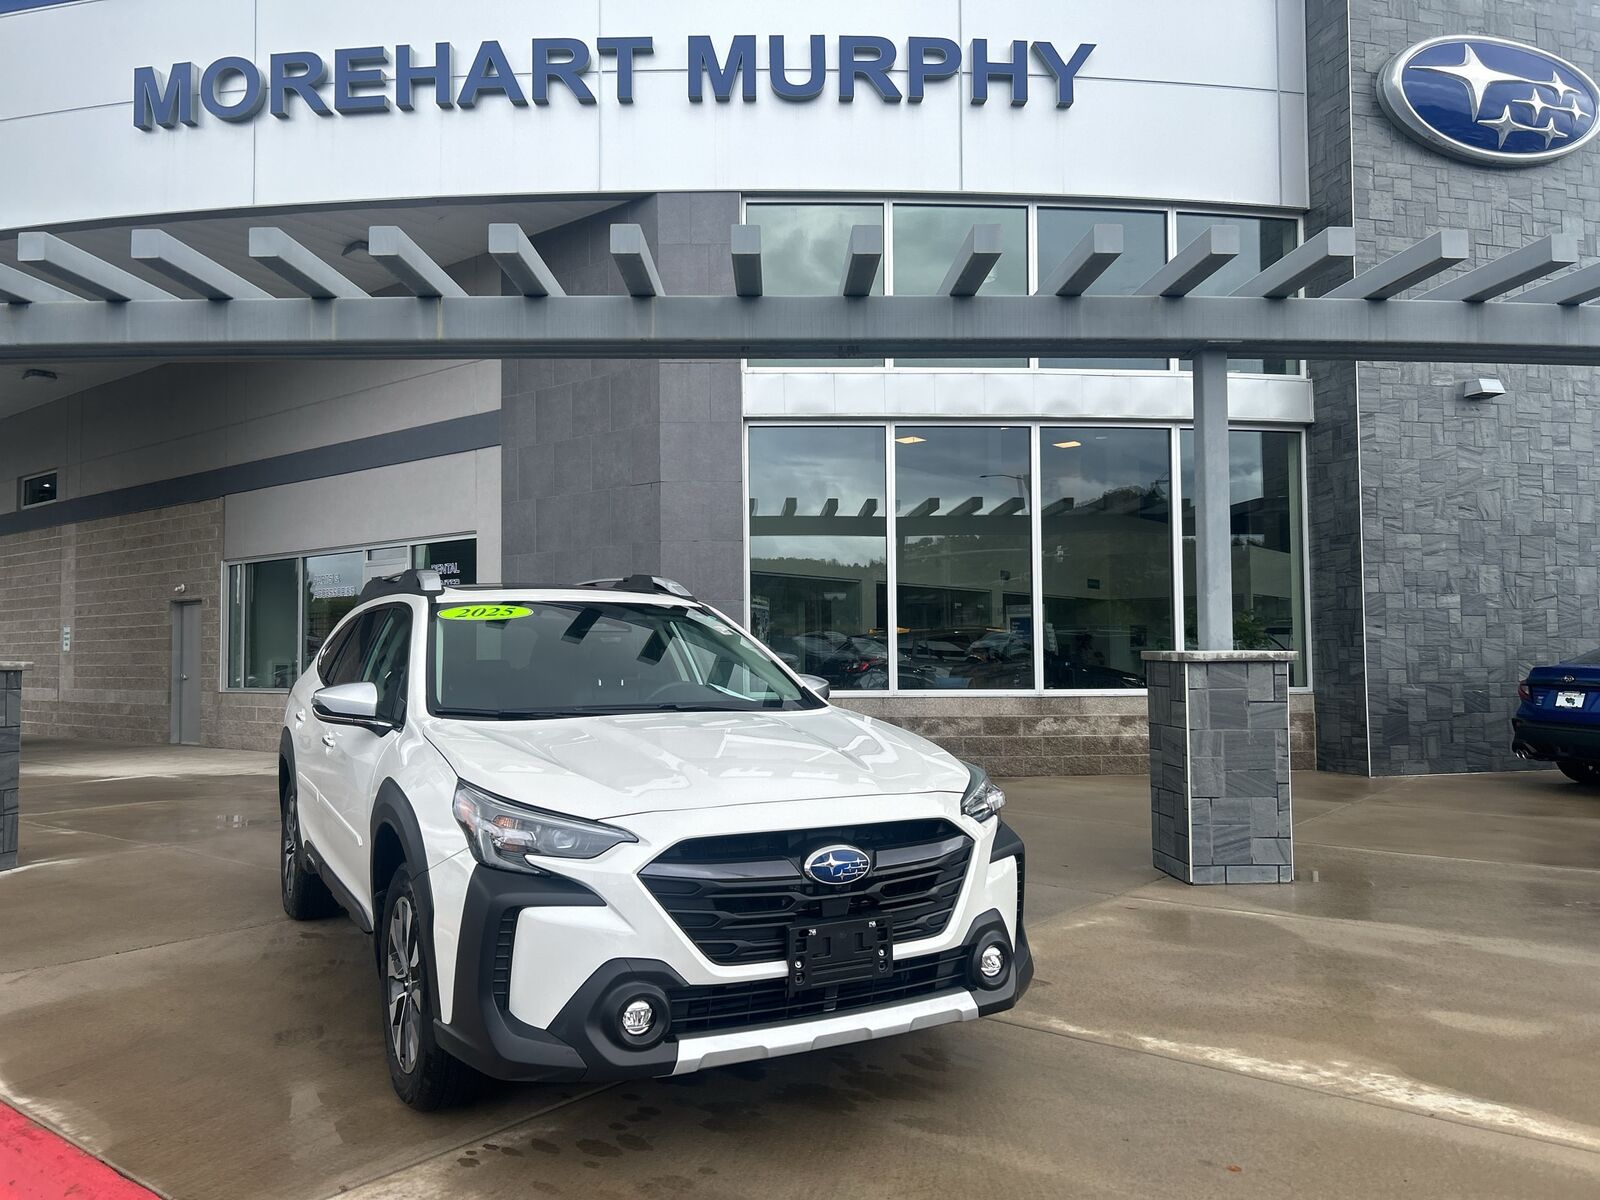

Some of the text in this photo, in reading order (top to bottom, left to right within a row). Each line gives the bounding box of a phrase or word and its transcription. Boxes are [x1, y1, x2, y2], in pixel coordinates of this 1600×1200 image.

[133, 34, 1097, 131] MOREHART MURPHY
[455, 607, 517, 618] 2025
